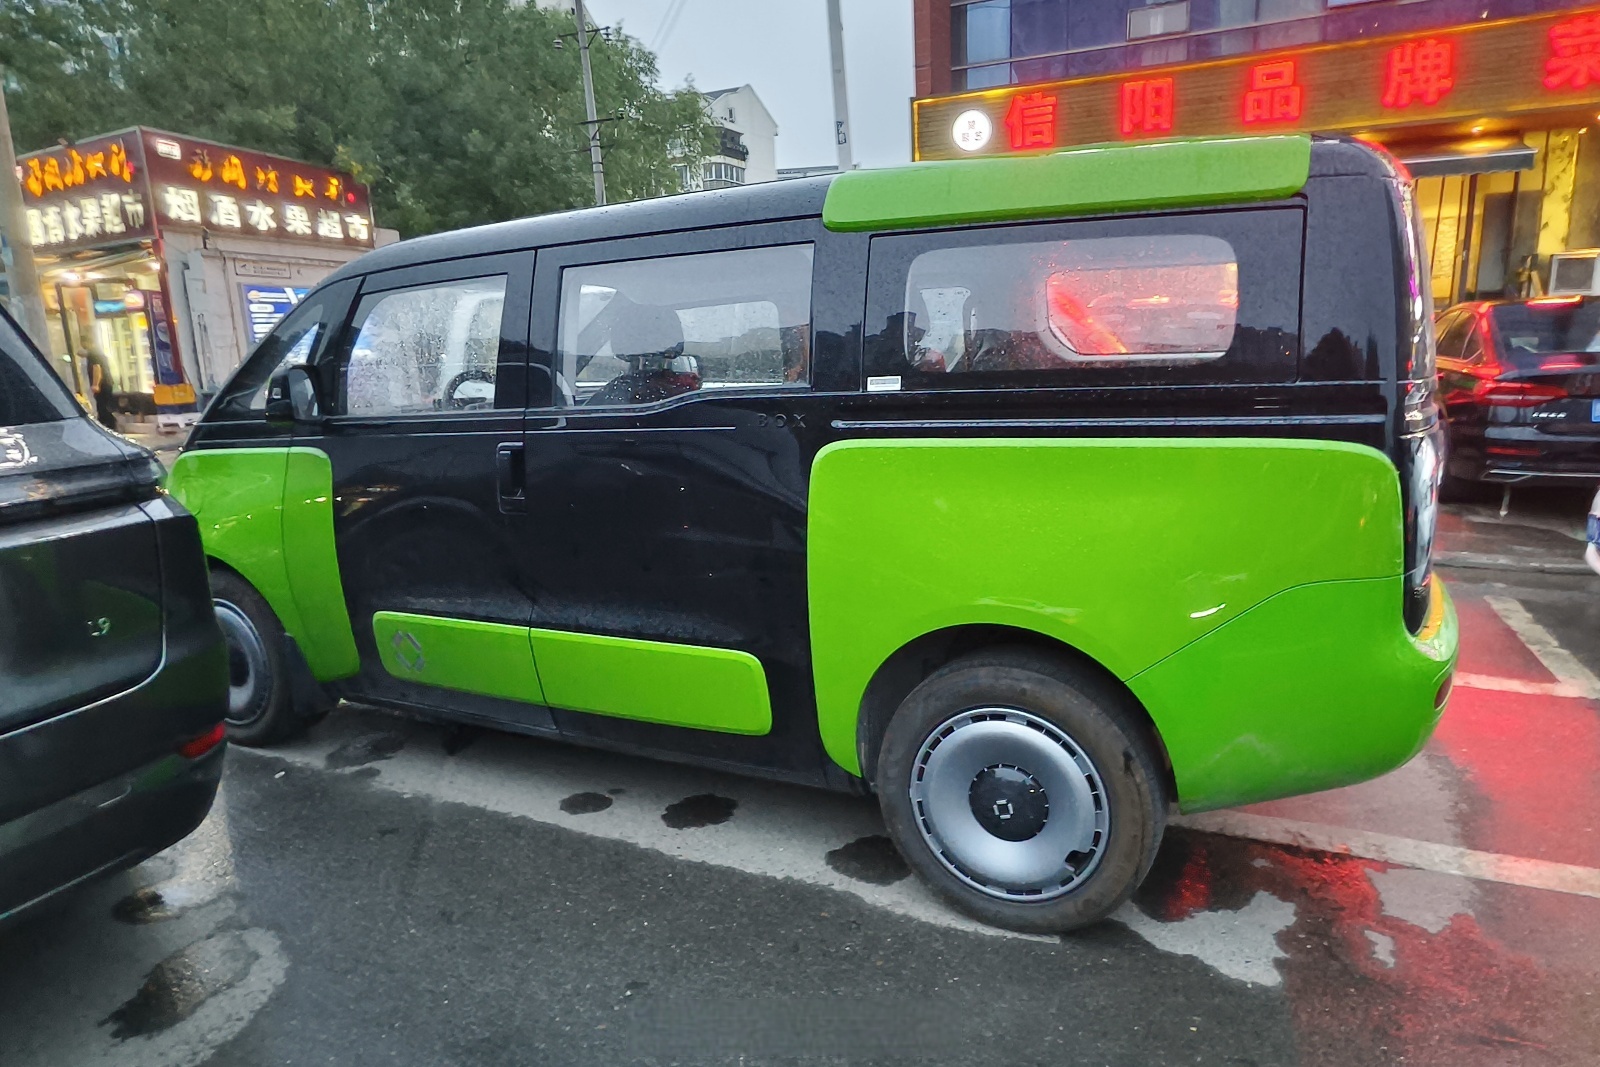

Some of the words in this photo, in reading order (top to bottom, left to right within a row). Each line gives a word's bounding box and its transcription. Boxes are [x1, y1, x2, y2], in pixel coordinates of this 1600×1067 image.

[164, 186, 369, 241] 烟酒水果超市
[757, 413, 806, 428] BOX
